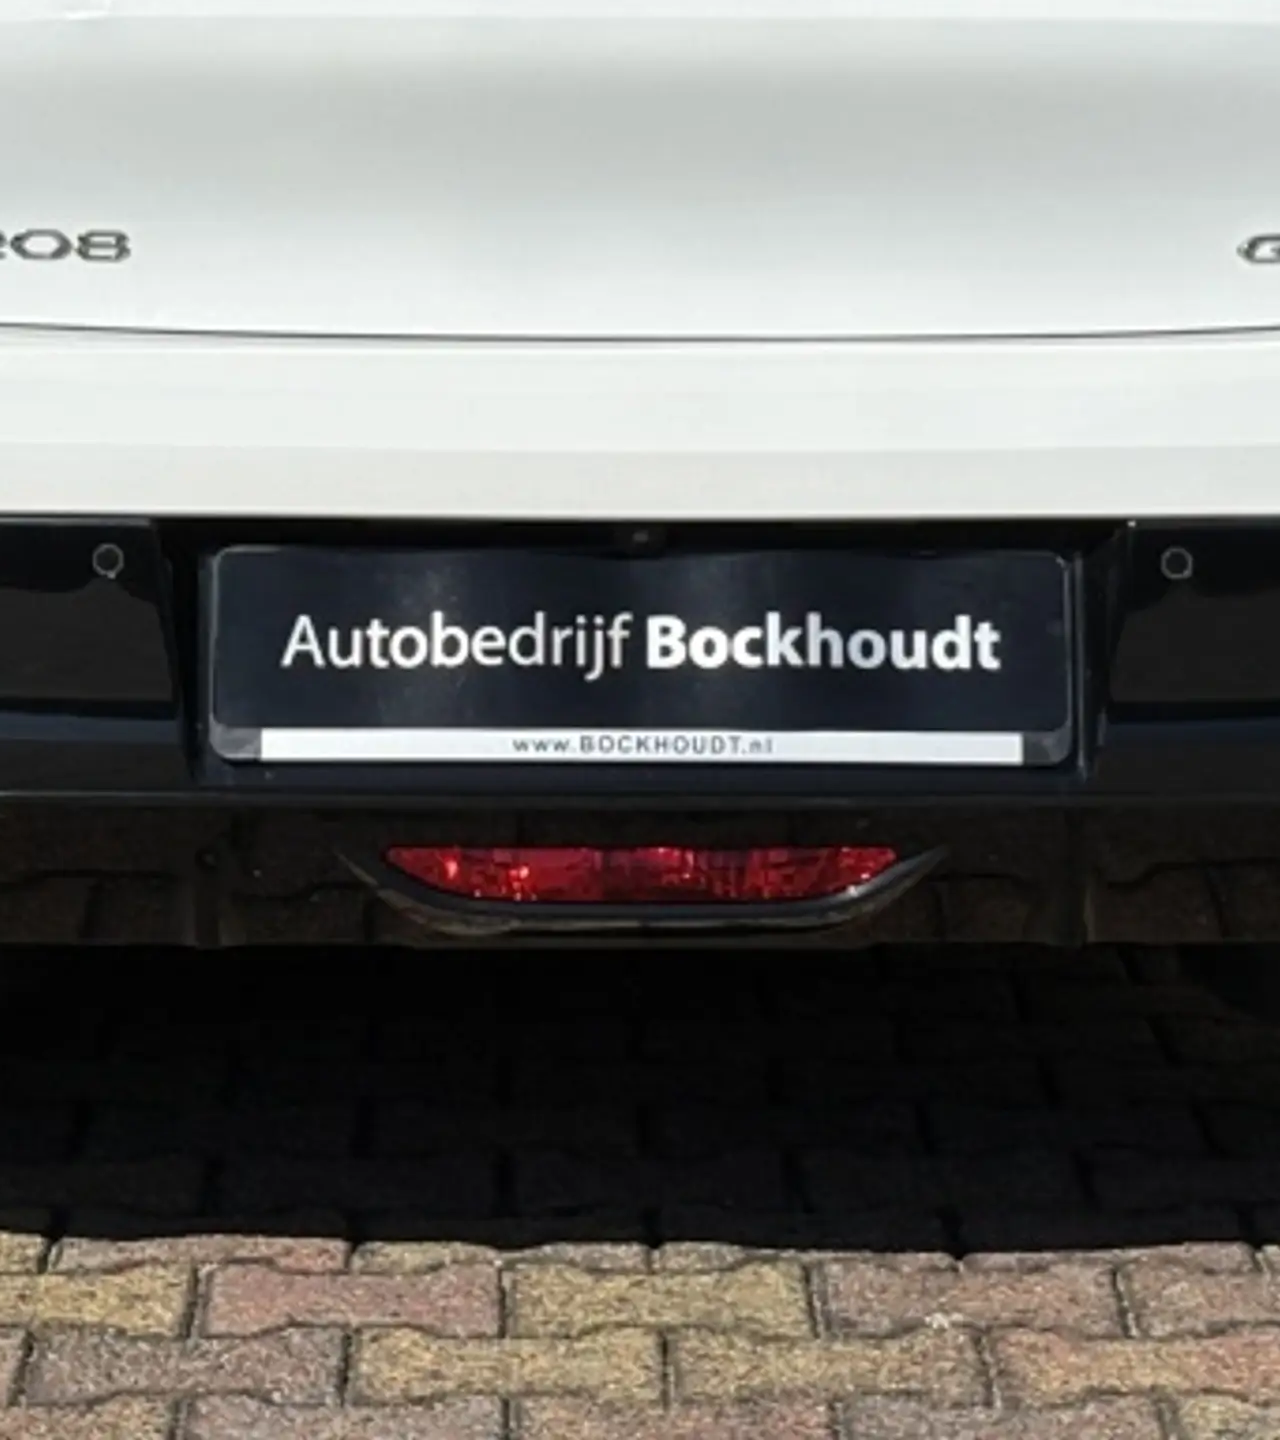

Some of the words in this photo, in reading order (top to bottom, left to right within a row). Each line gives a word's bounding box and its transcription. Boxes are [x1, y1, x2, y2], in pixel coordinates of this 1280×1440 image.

[280, 610, 634, 682] Autobedrijf
[645, 610, 1002, 670] Bockhoudt
[511, 734, 774, 756] www.BOCKHOUDT.nl
